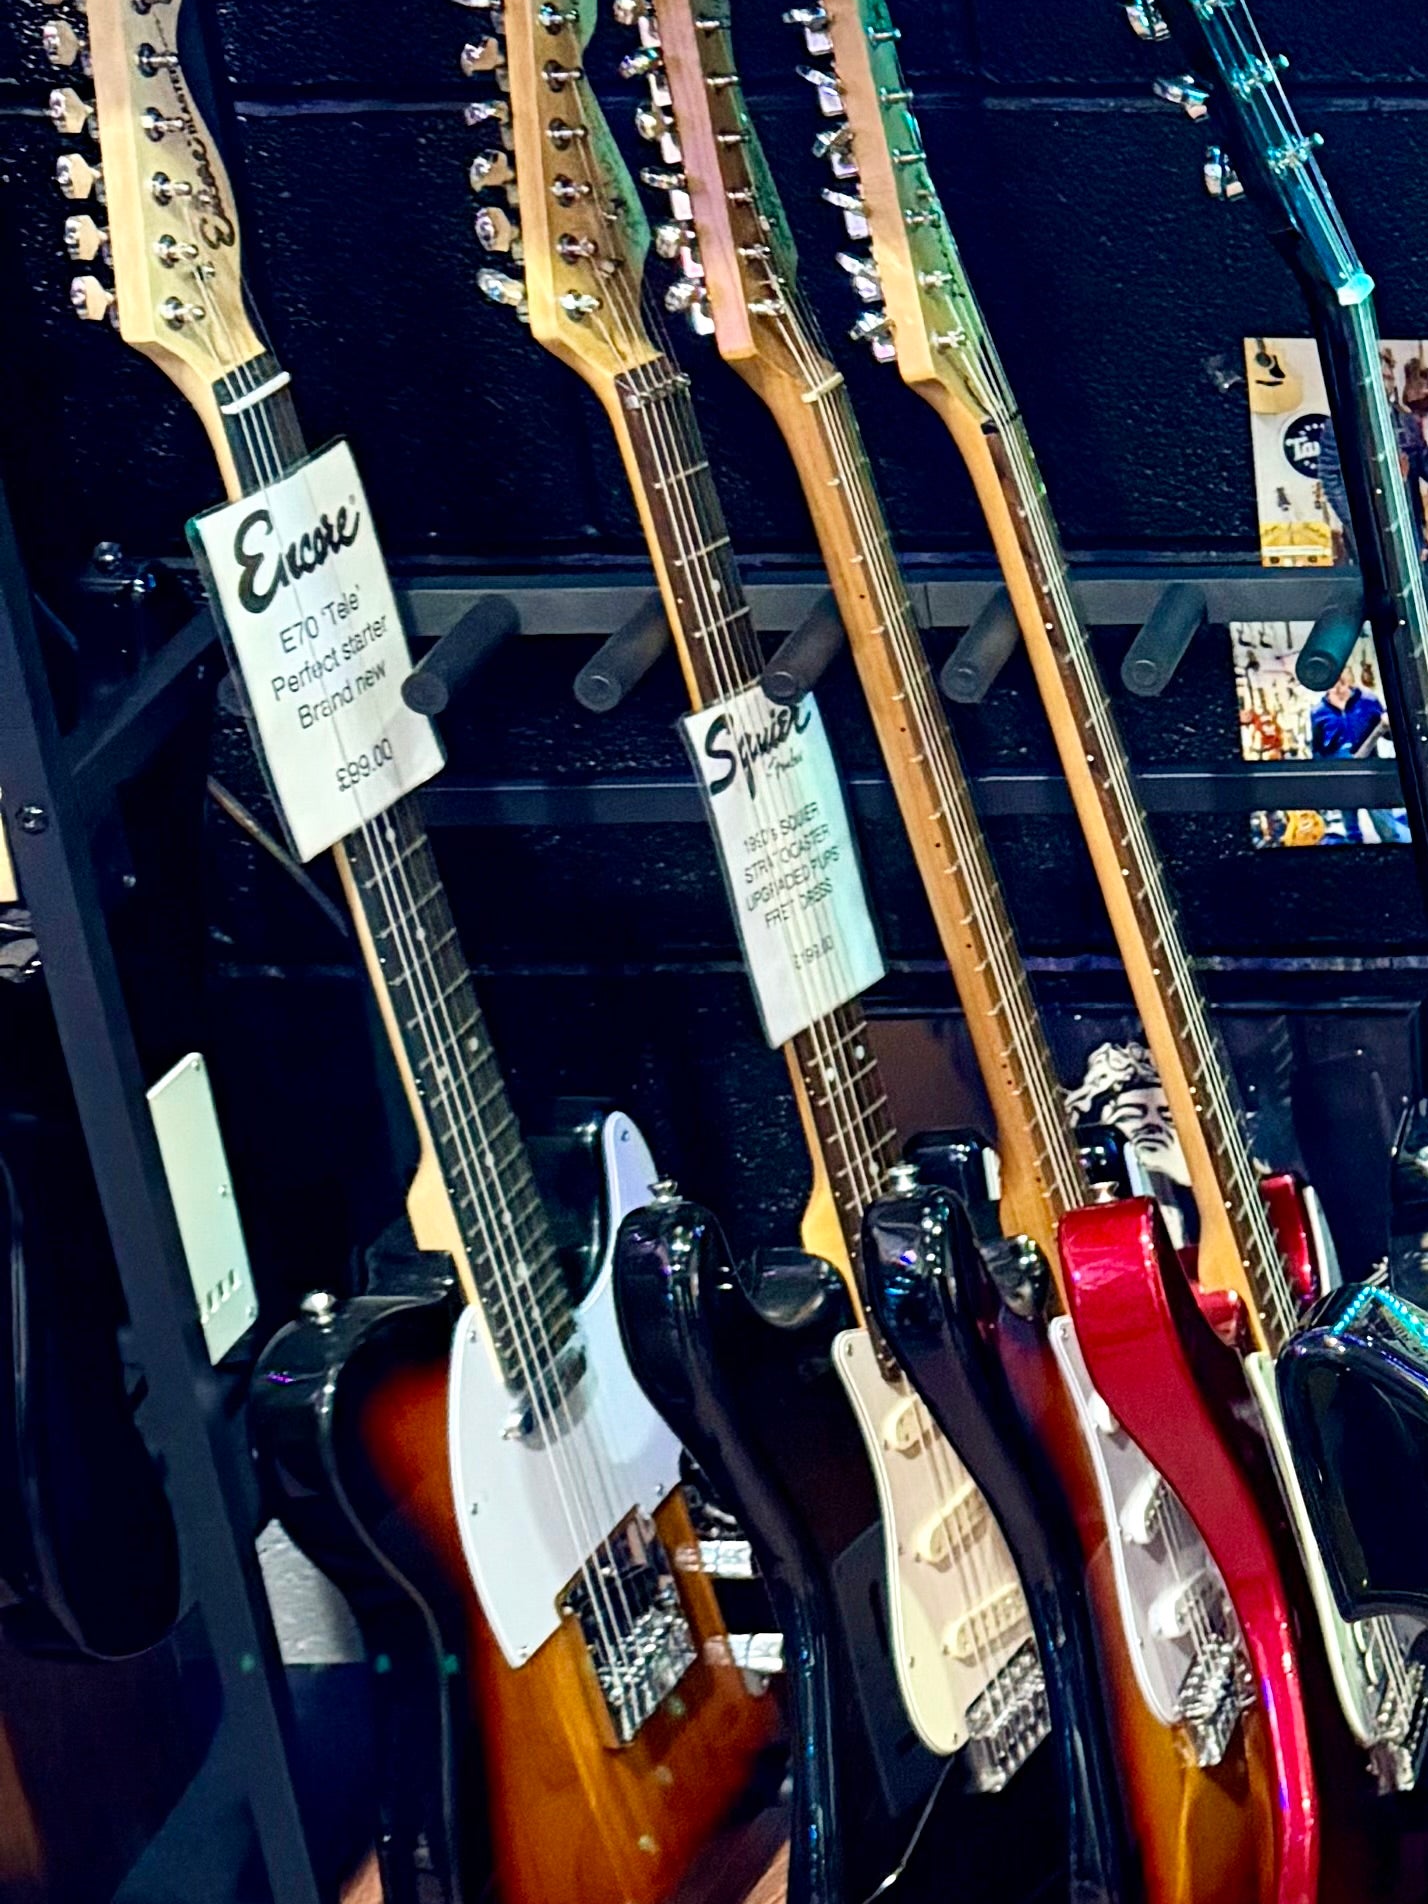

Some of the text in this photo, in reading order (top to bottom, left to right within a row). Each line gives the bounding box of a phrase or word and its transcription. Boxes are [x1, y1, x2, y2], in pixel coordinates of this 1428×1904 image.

[233, 504, 360, 614] Encore
[271, 614, 388, 702] Perfect starter
[280, 615, 320, 655] E70
[298, 661, 386, 731] Brand new
[335, 737, 393, 792] £99.00
